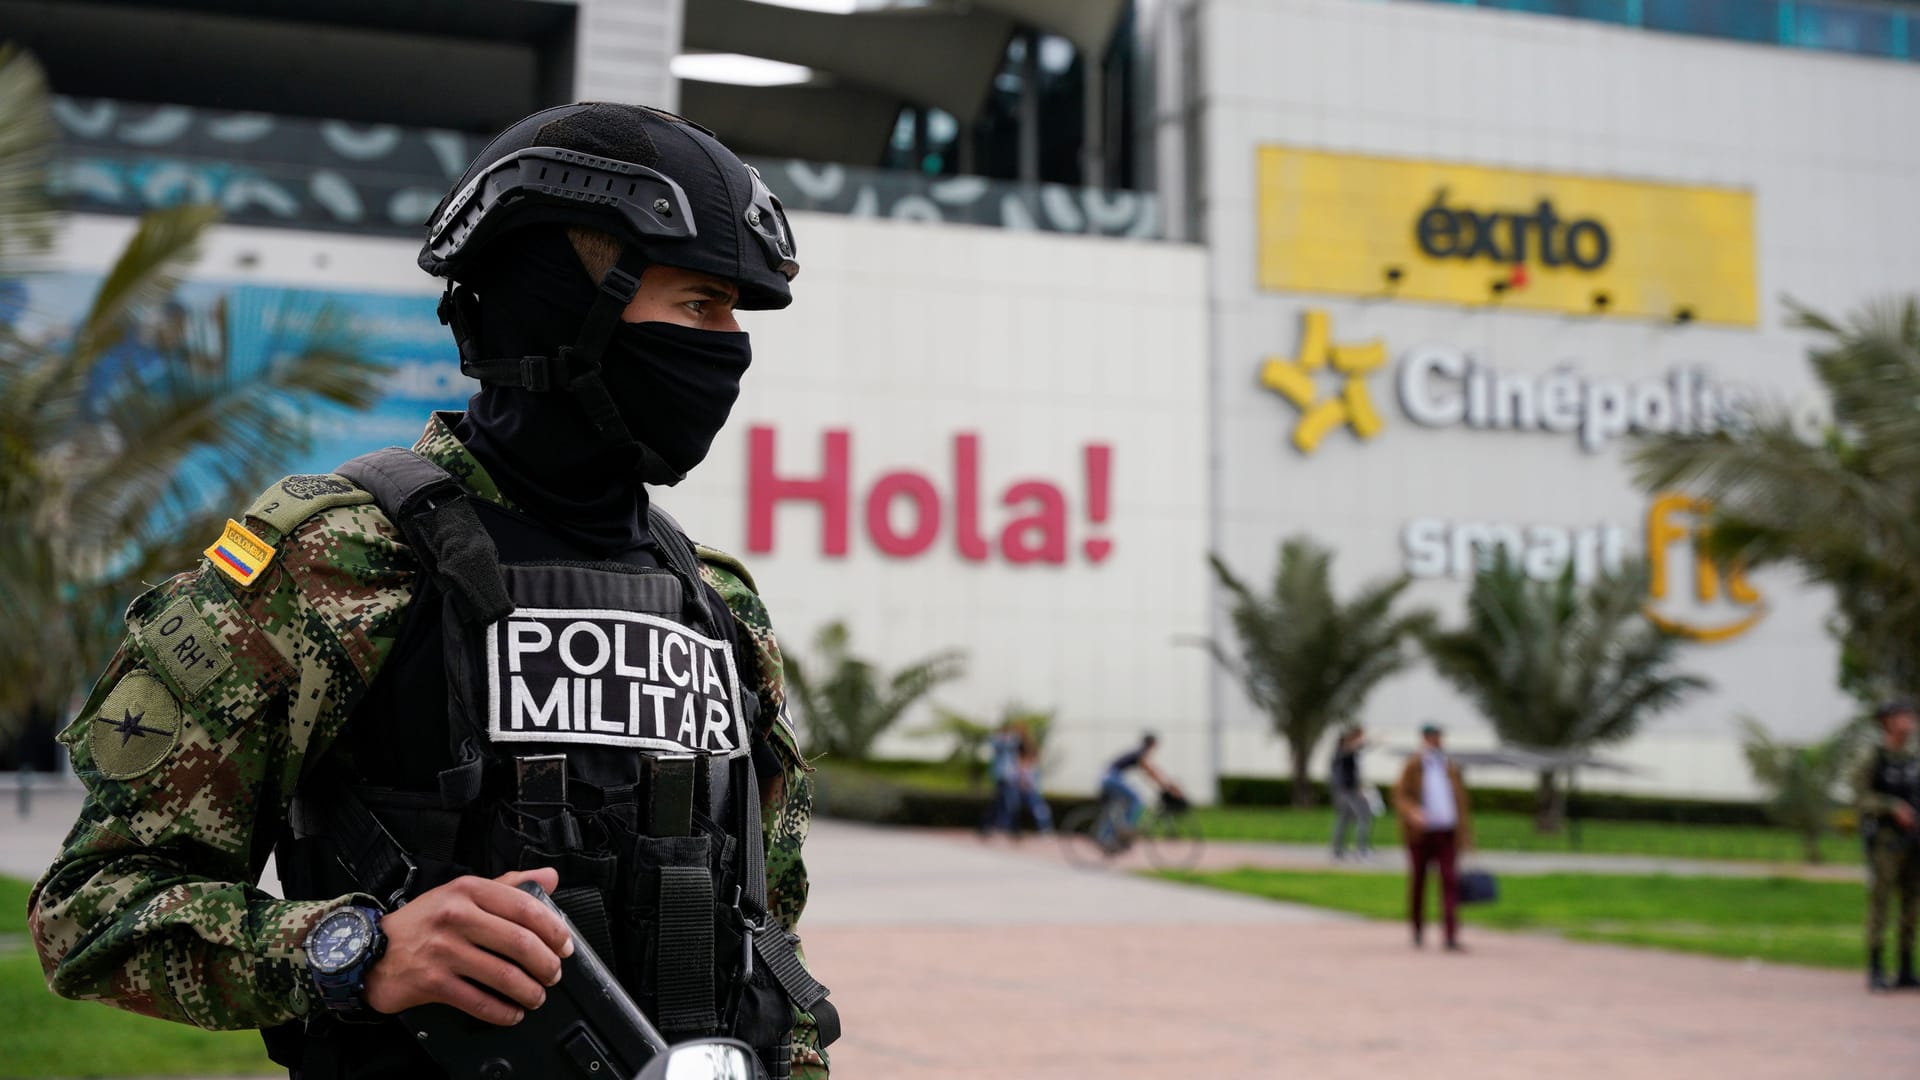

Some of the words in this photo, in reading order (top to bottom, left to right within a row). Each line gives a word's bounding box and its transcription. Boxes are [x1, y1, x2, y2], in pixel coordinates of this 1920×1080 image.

[1417, 188, 1611, 288] éxito
[264, 502, 279, 514] 2
[746, 426, 1113, 565] Hola!
[228, 530, 266, 562] COLOMBIA
[508, 621, 729, 700] POLICIA
[511, 676, 735, 750] MILITAR
